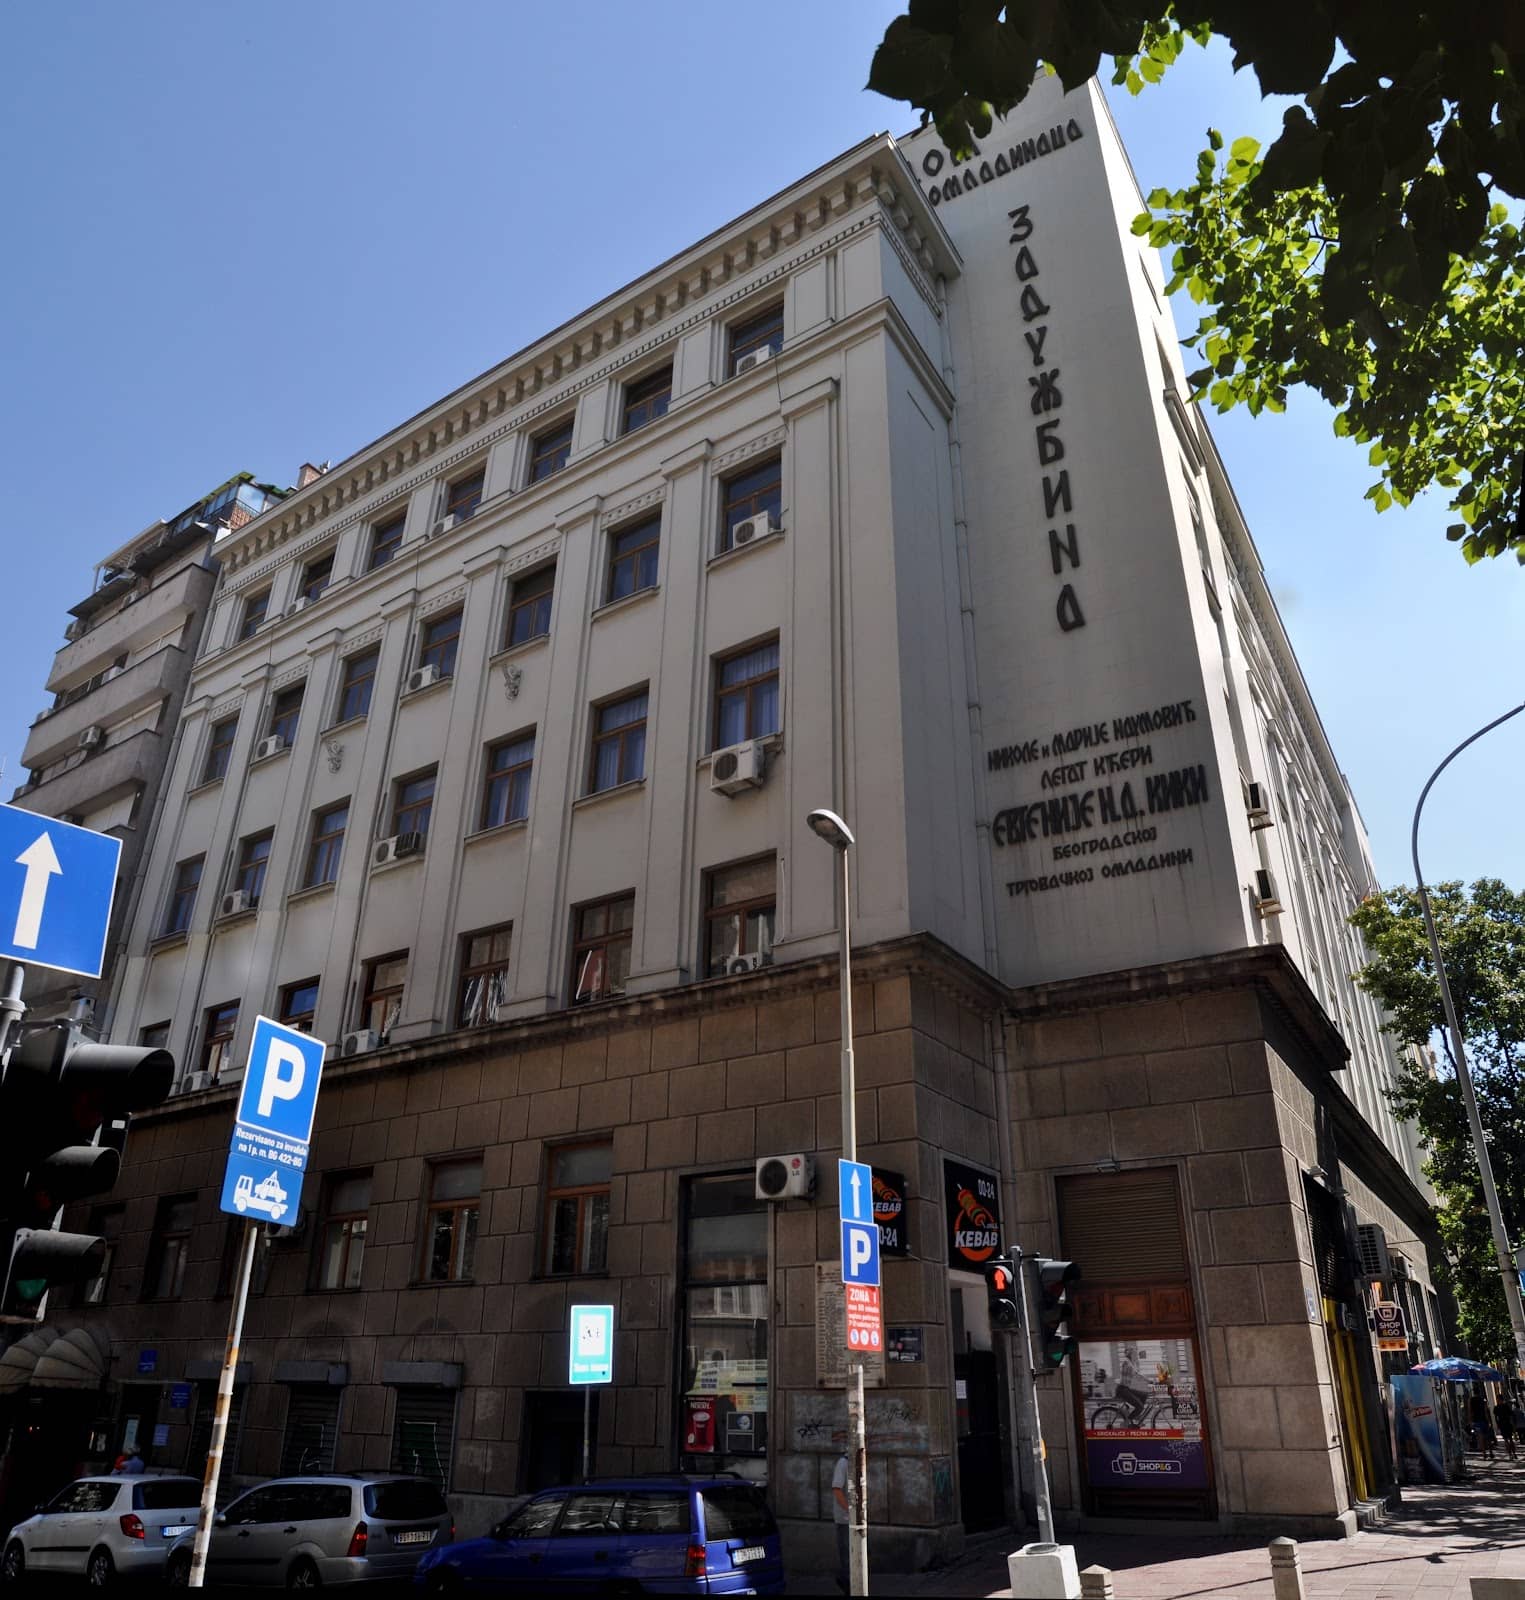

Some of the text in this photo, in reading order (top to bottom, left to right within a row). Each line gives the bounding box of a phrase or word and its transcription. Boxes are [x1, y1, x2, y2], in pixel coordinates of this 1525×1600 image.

[1053, 826, 1157, 861] БЕОГРАДСКОЈ
[257, 1036, 306, 1118] P
[872, 1202, 901, 1213] EBAB
[955, 1230, 998, 1248] KEBAB
[850, 1228, 872, 1277] P
[1378, 1321, 1400, 1329] SHOP
